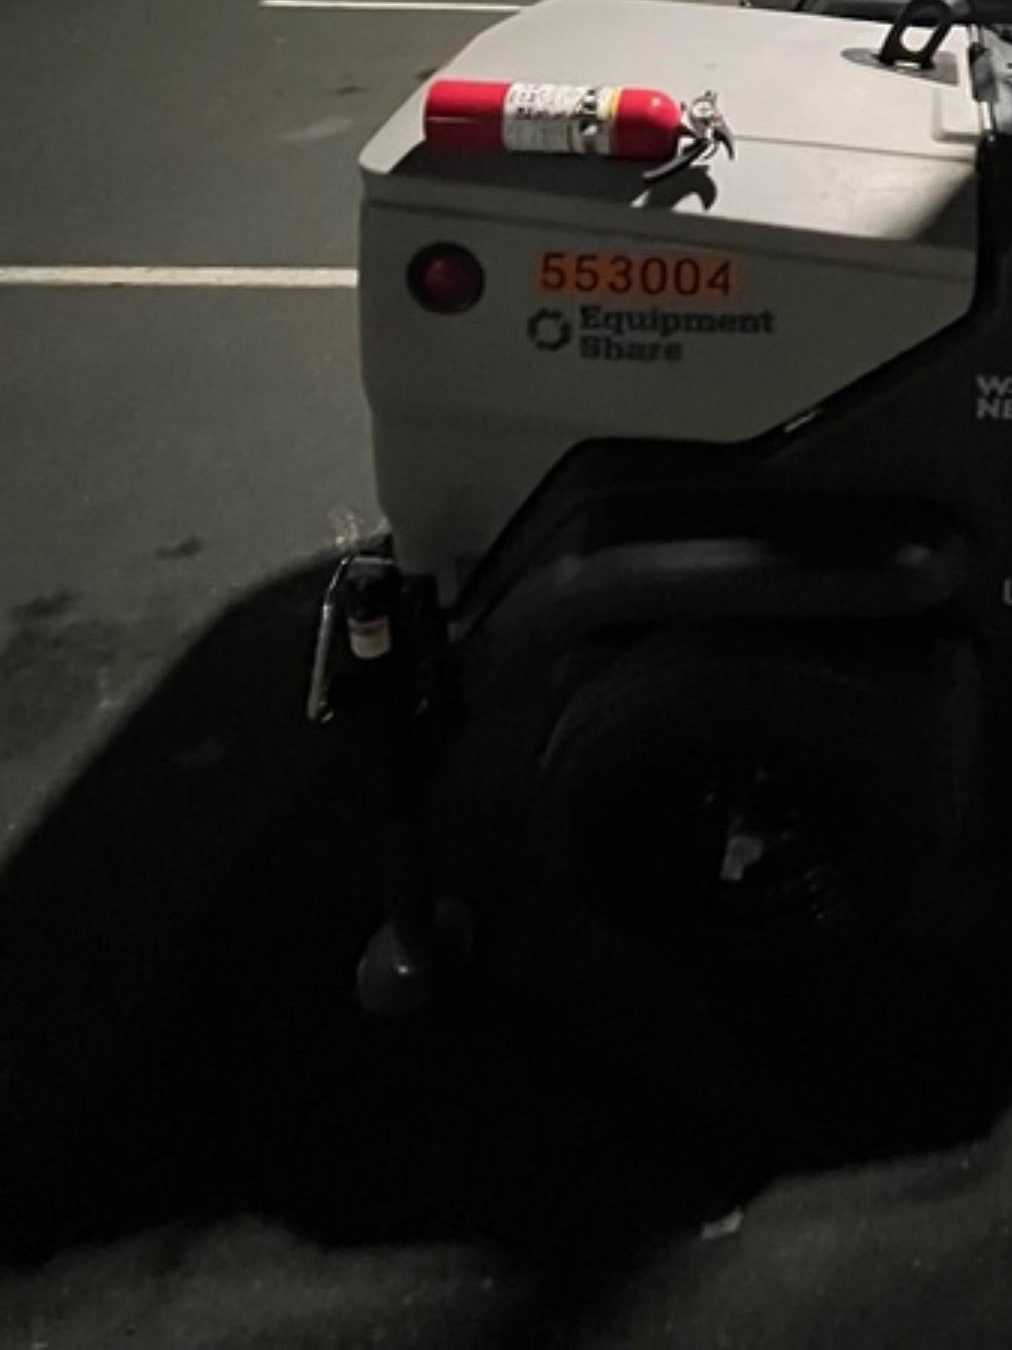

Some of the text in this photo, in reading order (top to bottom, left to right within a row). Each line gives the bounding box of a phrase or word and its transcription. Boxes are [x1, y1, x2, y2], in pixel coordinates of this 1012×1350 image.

[541, 253, 731, 297] 553004
[579, 306, 774, 337] Equipment
[579, 336, 683, 362] Share
